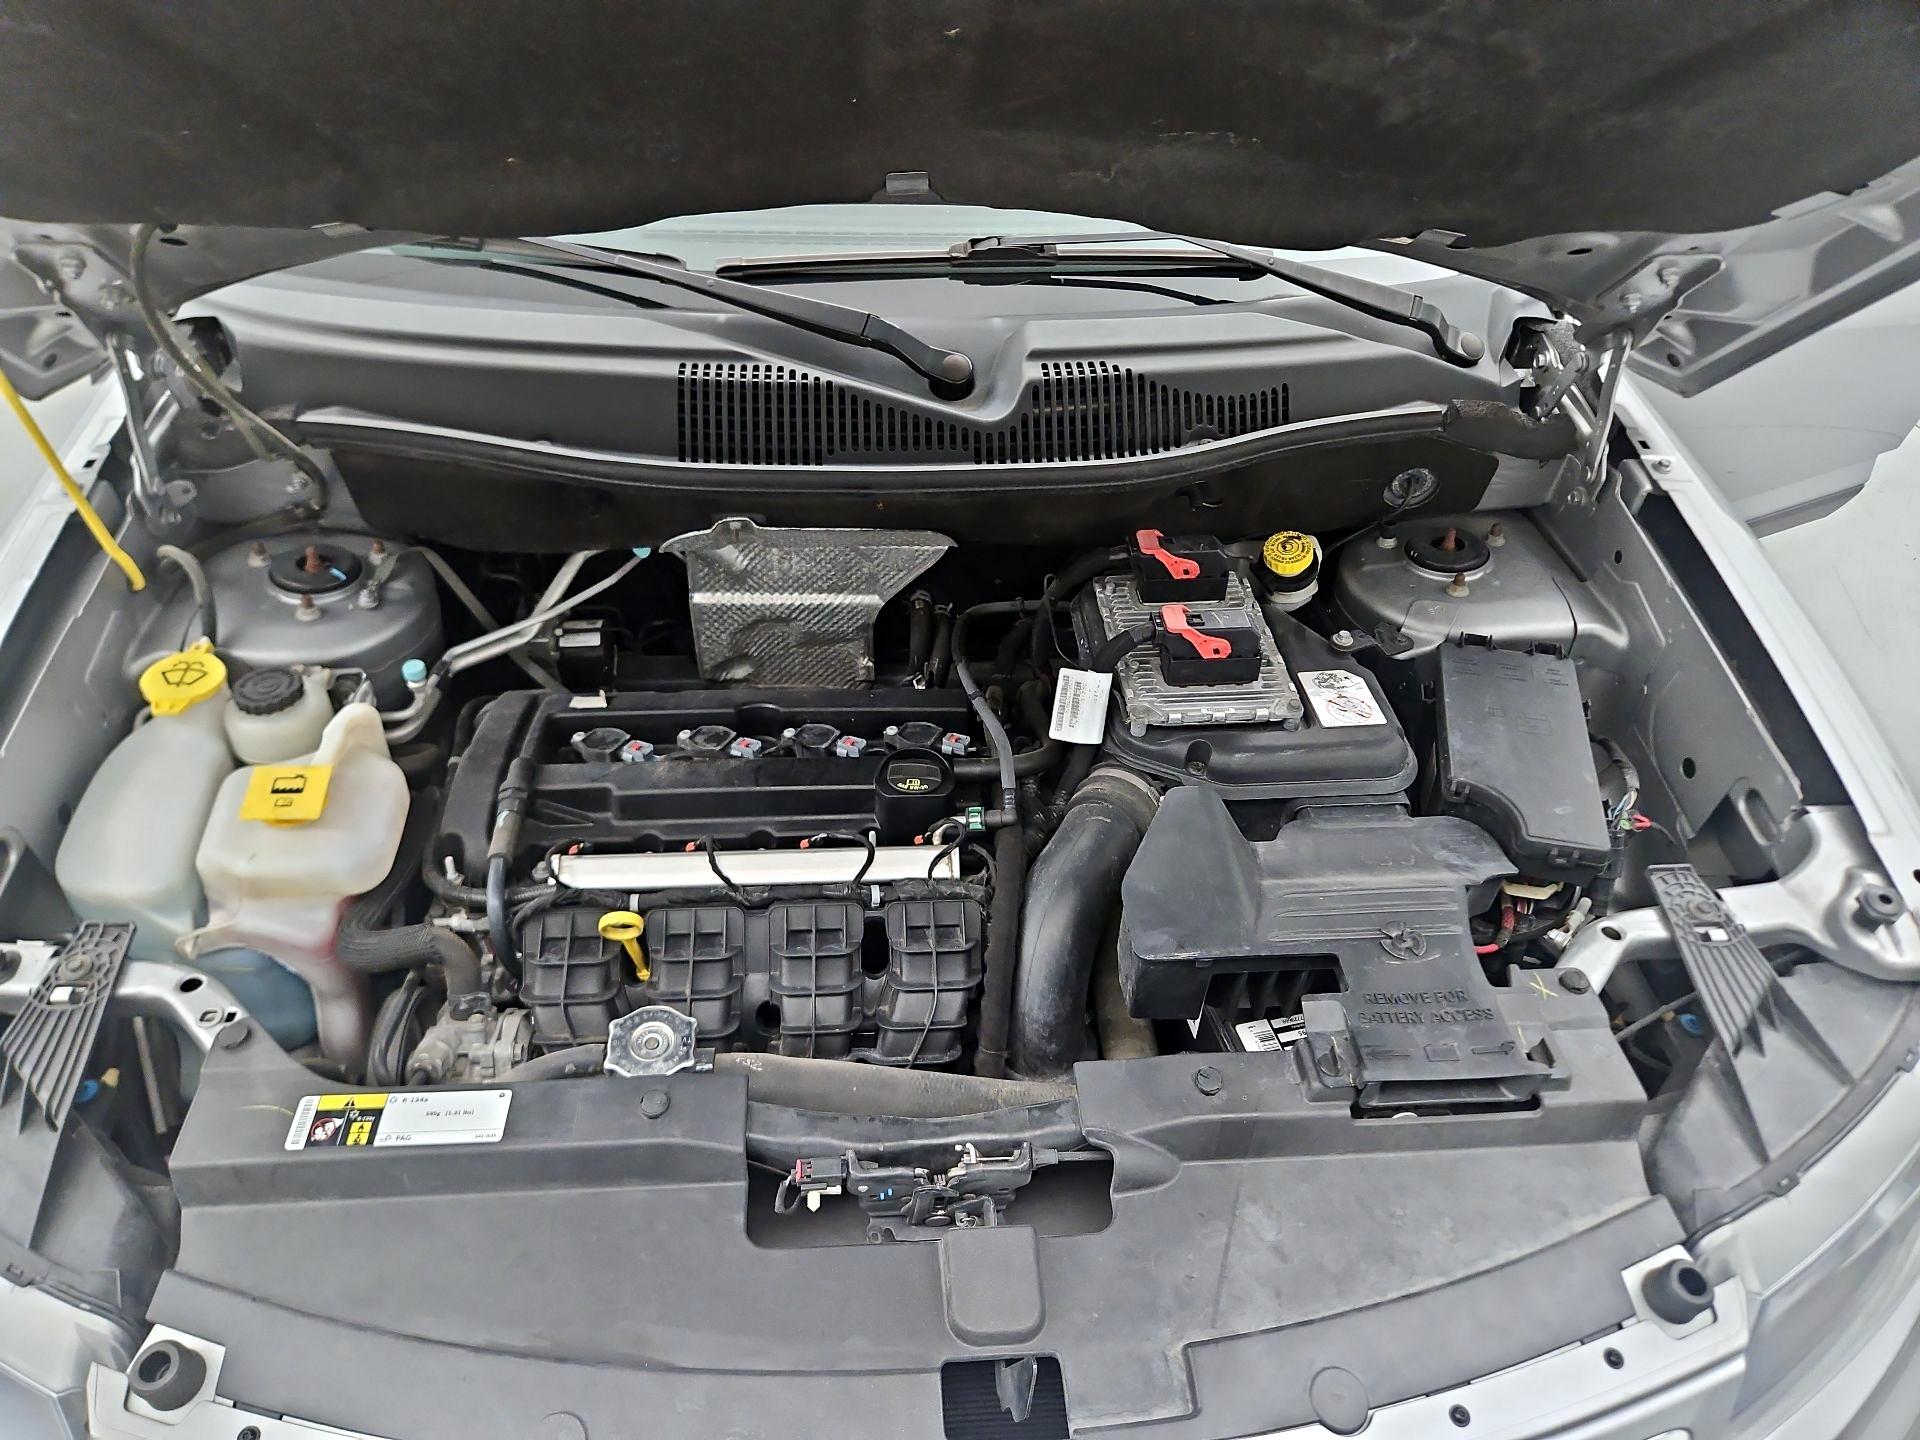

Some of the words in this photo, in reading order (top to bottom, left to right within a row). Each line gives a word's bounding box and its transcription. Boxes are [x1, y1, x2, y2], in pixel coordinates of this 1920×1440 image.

[1363, 990, 1432, 1004] REMOVE
[1434, 989, 1468, 1003] FOR
[1358, 1011, 1425, 1024] BATTERY
[1431, 1008, 1495, 1023] ACCESS
